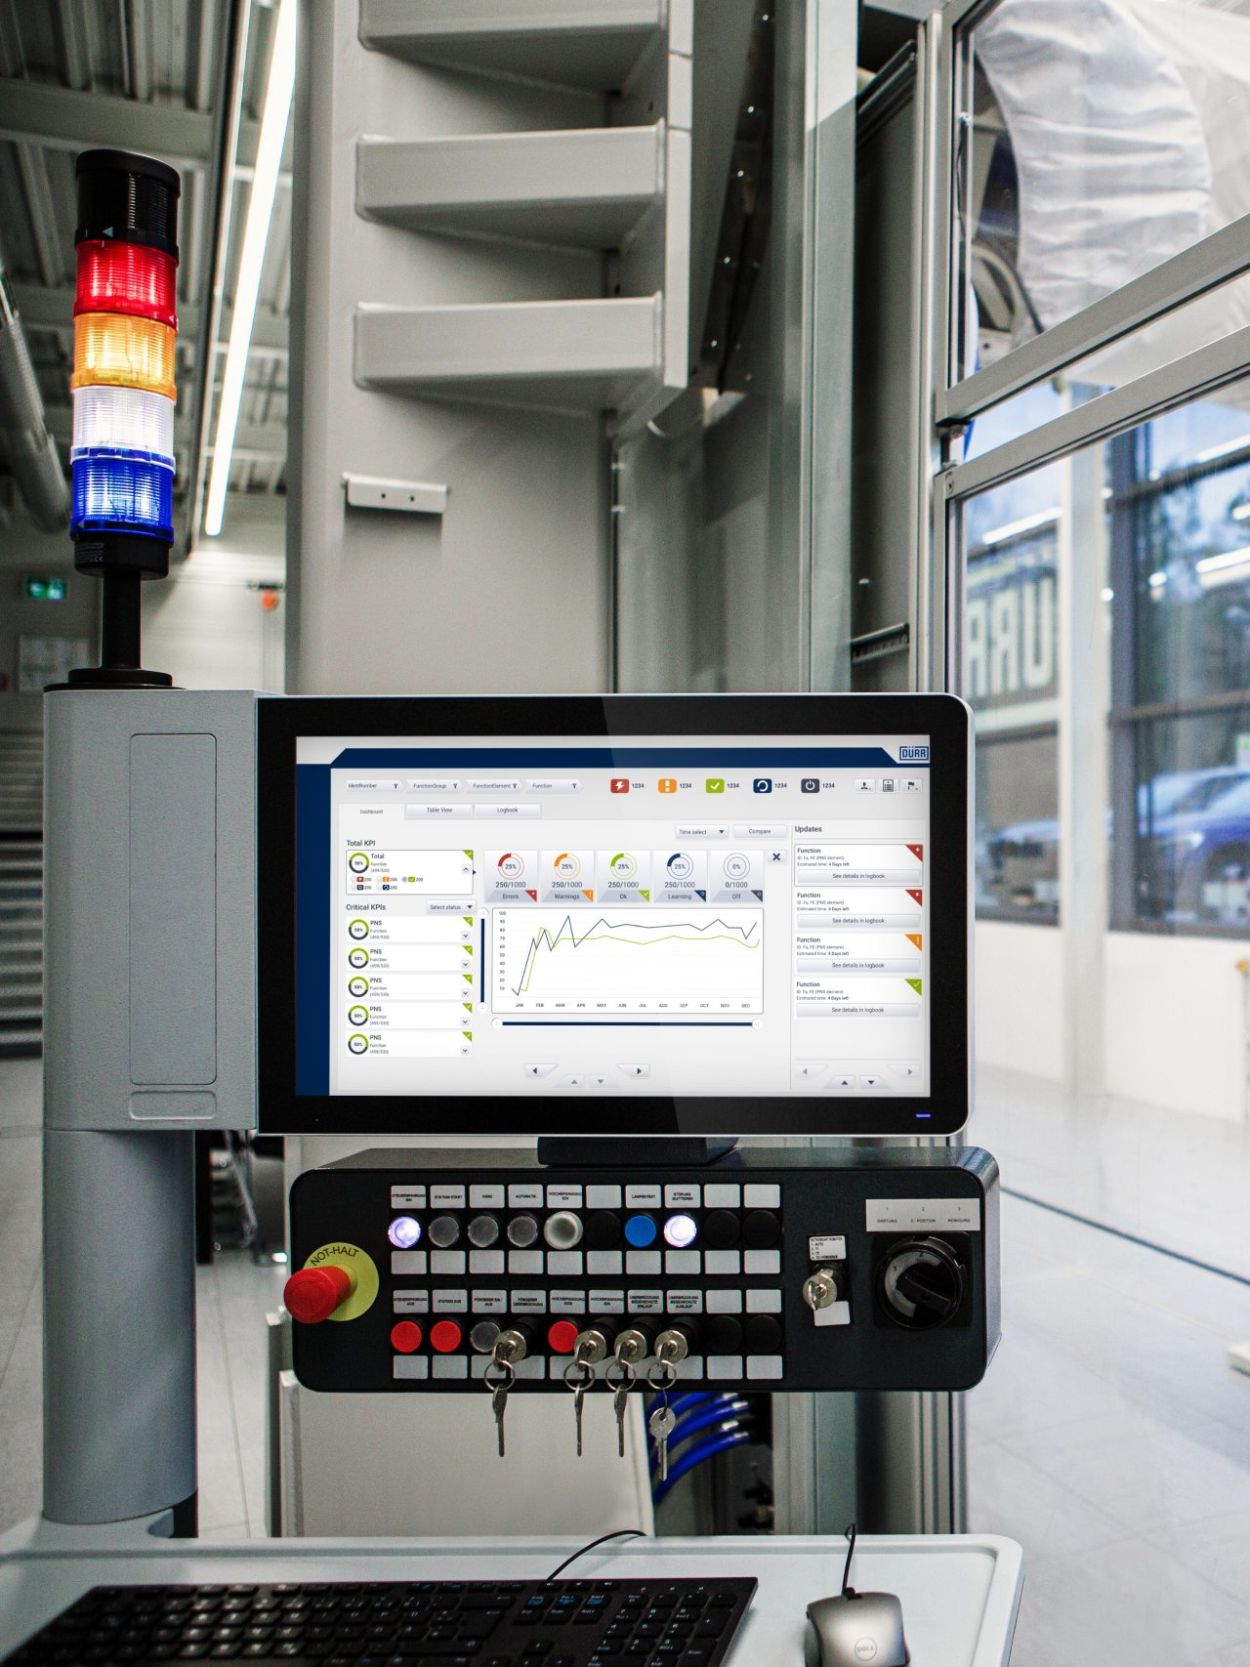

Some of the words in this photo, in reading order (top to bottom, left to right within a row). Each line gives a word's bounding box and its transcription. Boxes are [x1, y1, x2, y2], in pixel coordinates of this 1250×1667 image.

[901, 746, 928, 759] DÜRR
[497, 807, 518, 815] Logbook
[748, 828, 771, 836] Compare
[794, 825, 823, 834] Updates
[346, 839, 363, 847] Total
[363, 839, 376, 847] KPI
[495, 881, 527, 889] 250/1000
[551, 881, 583, 889] 250/1000
[607, 881, 640, 889] 250/1000
[664, 881, 696, 889] 250/1000
[724, 881, 748, 889] 0/1000
[554, 893, 580, 901] Warnings
[667, 893, 692, 901] Learning
[345, 903, 369, 911] Critical
[370, 903, 386, 911] KPIs
[310, 1246, 360, 1267] NOT-HALT
